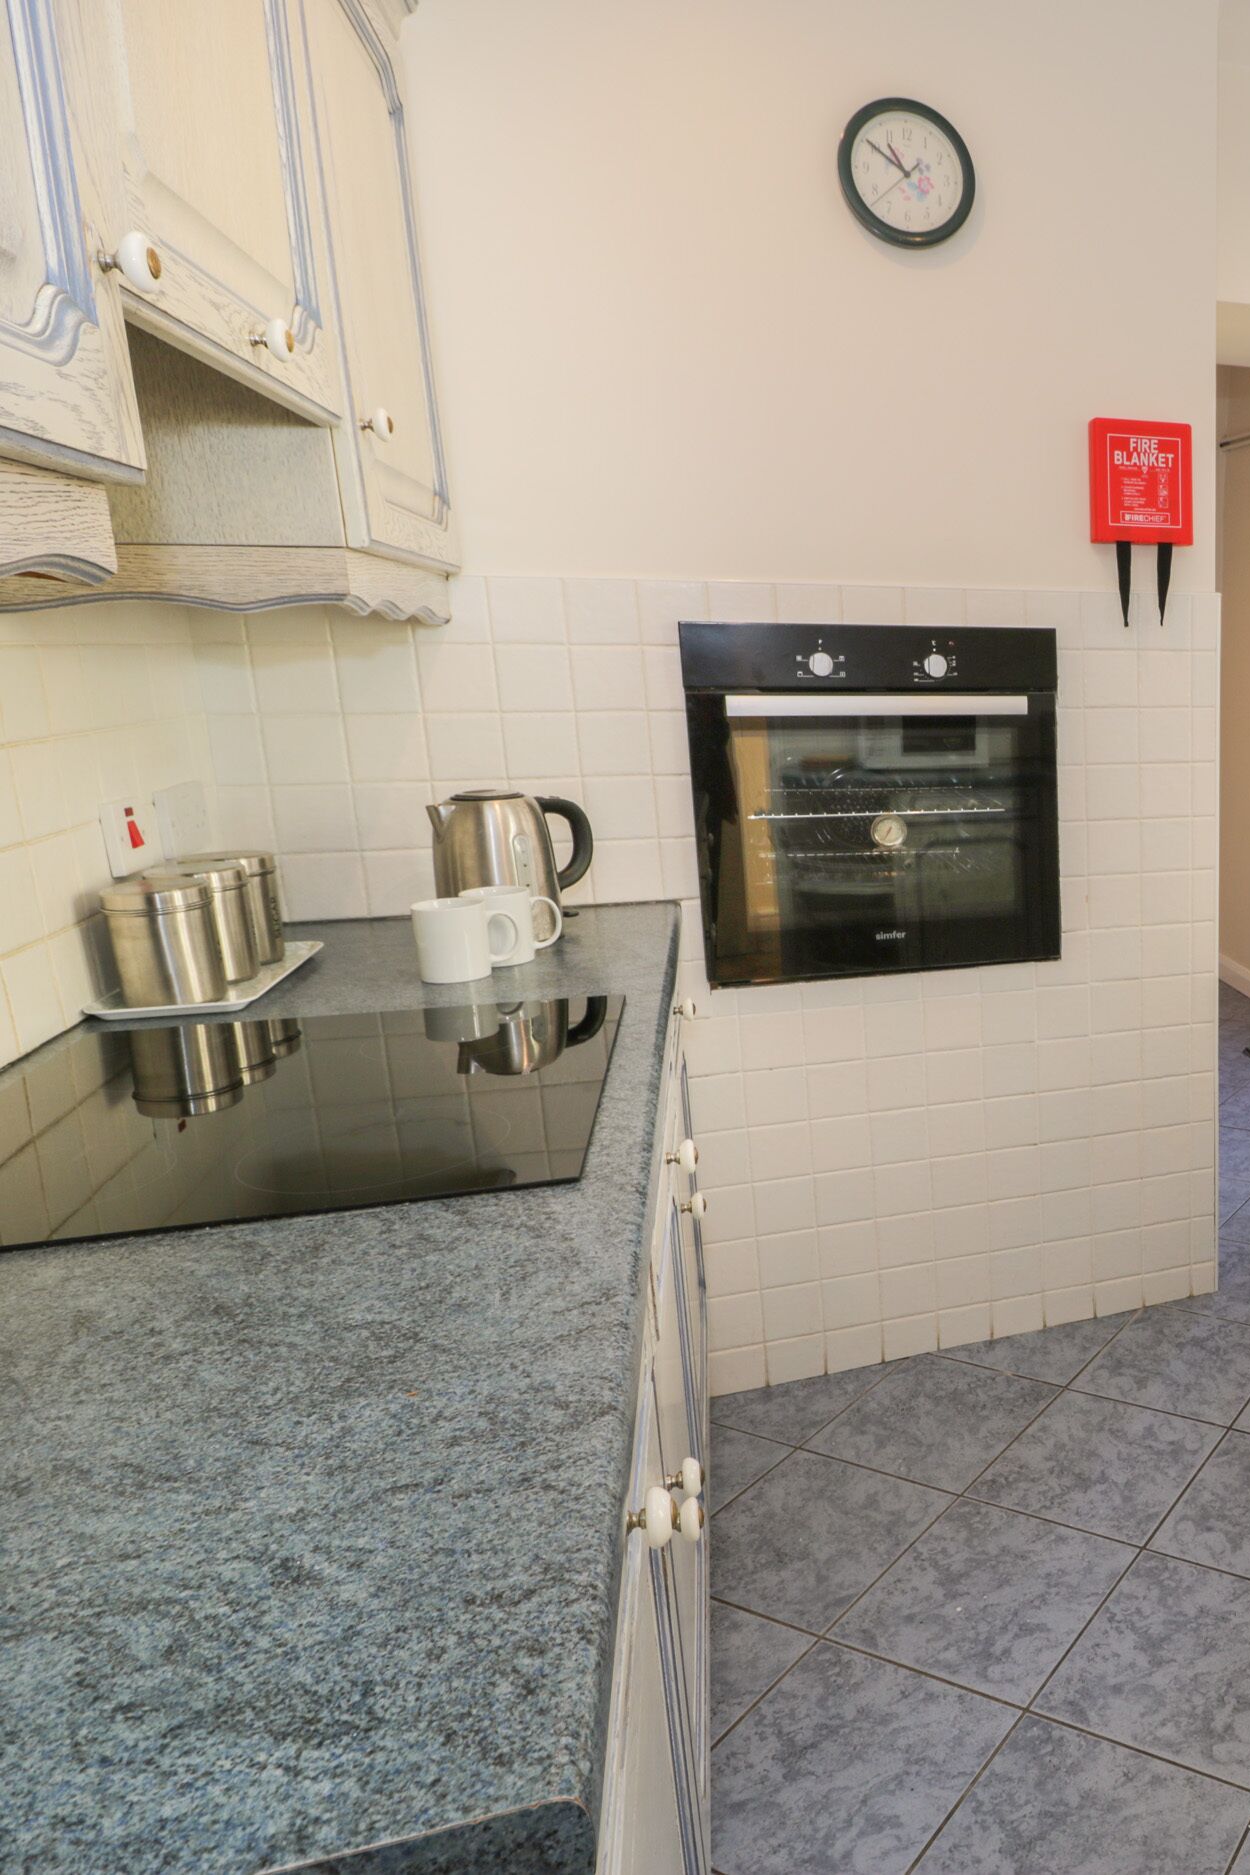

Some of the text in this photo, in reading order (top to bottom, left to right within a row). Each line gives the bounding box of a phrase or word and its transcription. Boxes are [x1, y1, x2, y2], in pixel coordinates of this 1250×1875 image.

[886, 129, 894, 144] 11
[902, 127, 913, 141] 12
[936, 152, 943, 166] 2
[862, 161, 870, 174] 9
[943, 174, 951, 187] 3
[871, 183, 879, 197] 8
[886, 200, 893, 213] 7
[923, 206, 931, 220] 5
[904, 210, 912, 222] 6
[1130, 438, 1158, 453] FIRE
[1114, 450, 1174, 467] BLANKET
[875, 930, 906, 940] simfer
